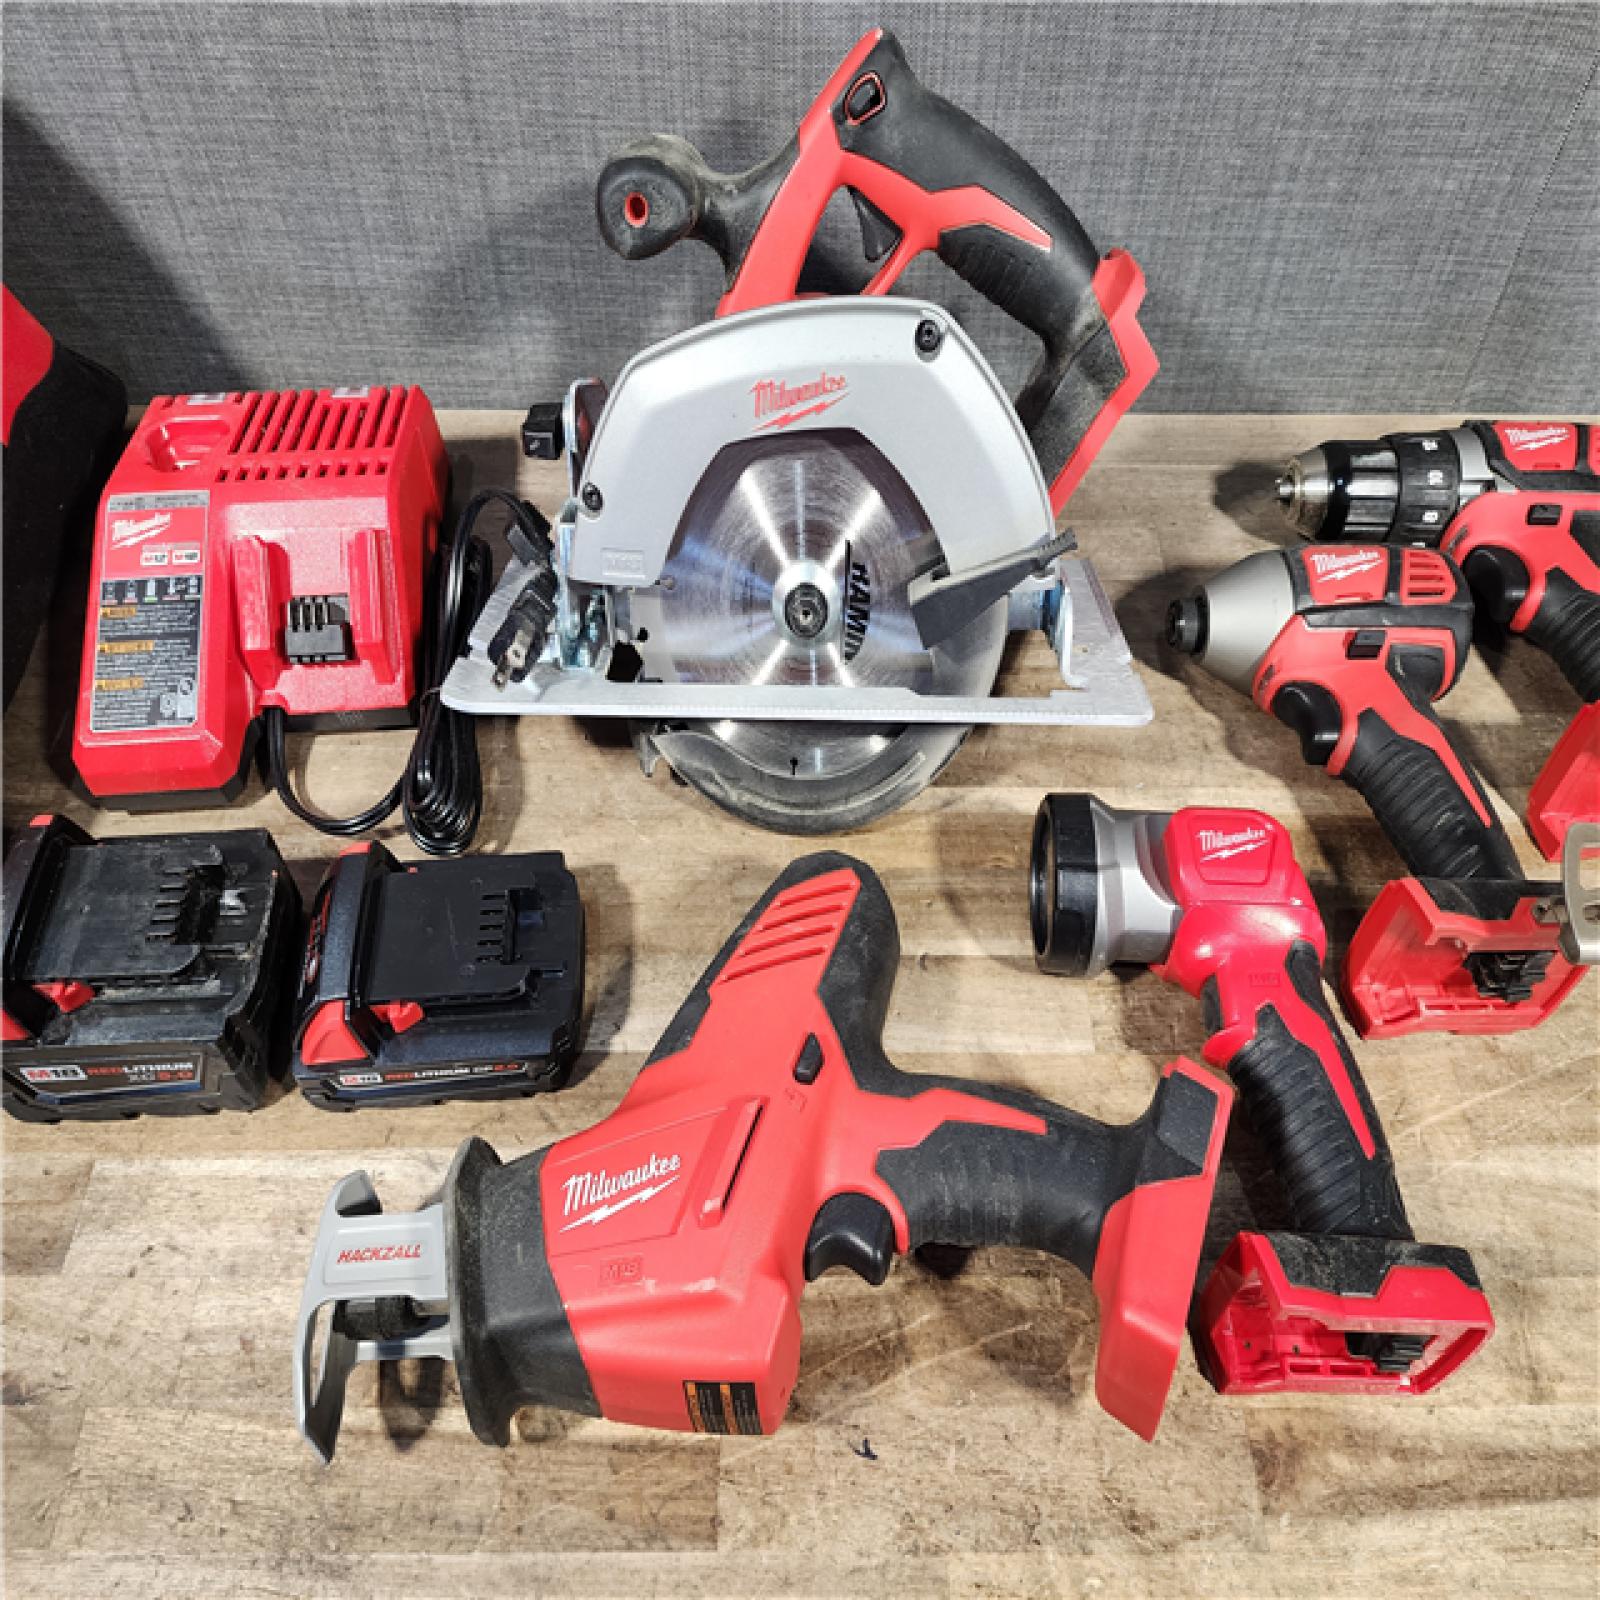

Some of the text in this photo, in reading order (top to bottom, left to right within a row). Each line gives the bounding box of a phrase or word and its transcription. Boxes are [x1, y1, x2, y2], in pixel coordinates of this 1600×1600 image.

[747, 370, 847, 418] Milwaukee
[1504, 427, 1569, 446] Milwaukee
[112, 512, 171, 542] Milwaukee
[1310, 549, 1380, 575] Milwaukee
[1195, 826, 1266, 851] Milwaukee
[560, 1152, 681, 1217] Milwaukee
[336, 1244, 421, 1264] HACKZALL
